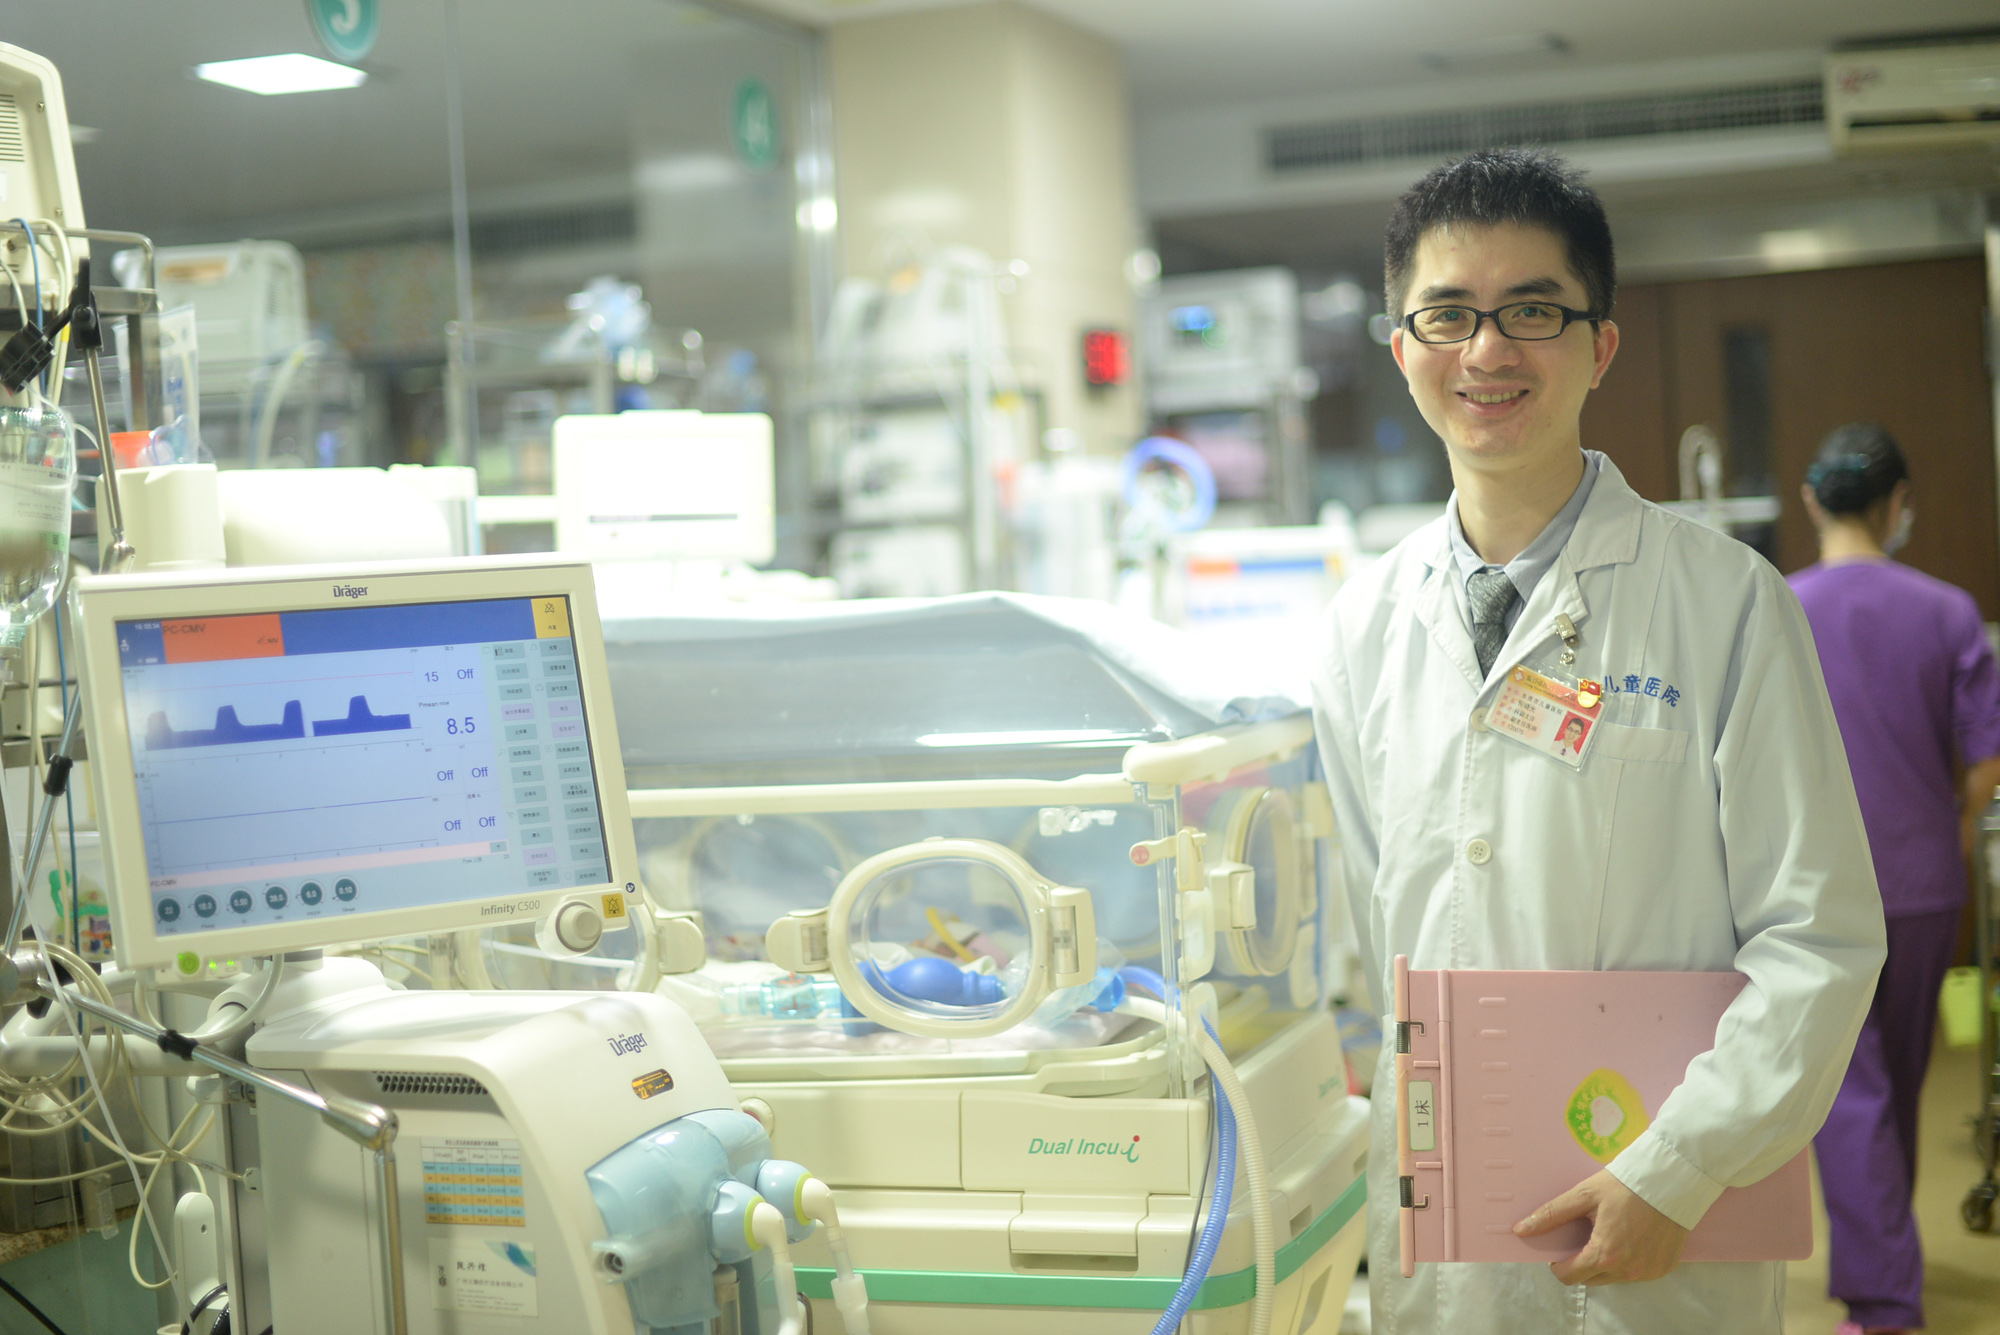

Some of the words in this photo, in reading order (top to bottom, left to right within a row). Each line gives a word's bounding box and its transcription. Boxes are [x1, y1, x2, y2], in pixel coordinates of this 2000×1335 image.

[333, 585, 368, 599] Dräger
[162, 624, 206, 635] PC-CMV
[424, 671, 439, 683] 15
[456, 668, 474, 680] Off
[1604, 674, 1681, 707] 儿童医院
[446, 716, 476, 735] 8.5
[437, 770, 454, 782] Off
[471, 766, 489, 778] Off
[444, 819, 462, 831] Off
[478, 816, 496, 828] Off
[481, 904, 516, 916] Infinity
[517, 900, 541, 912] C500
[607, 1033, 648, 1056] Dräger
[1028, 1138, 1074, 1155] Dual
